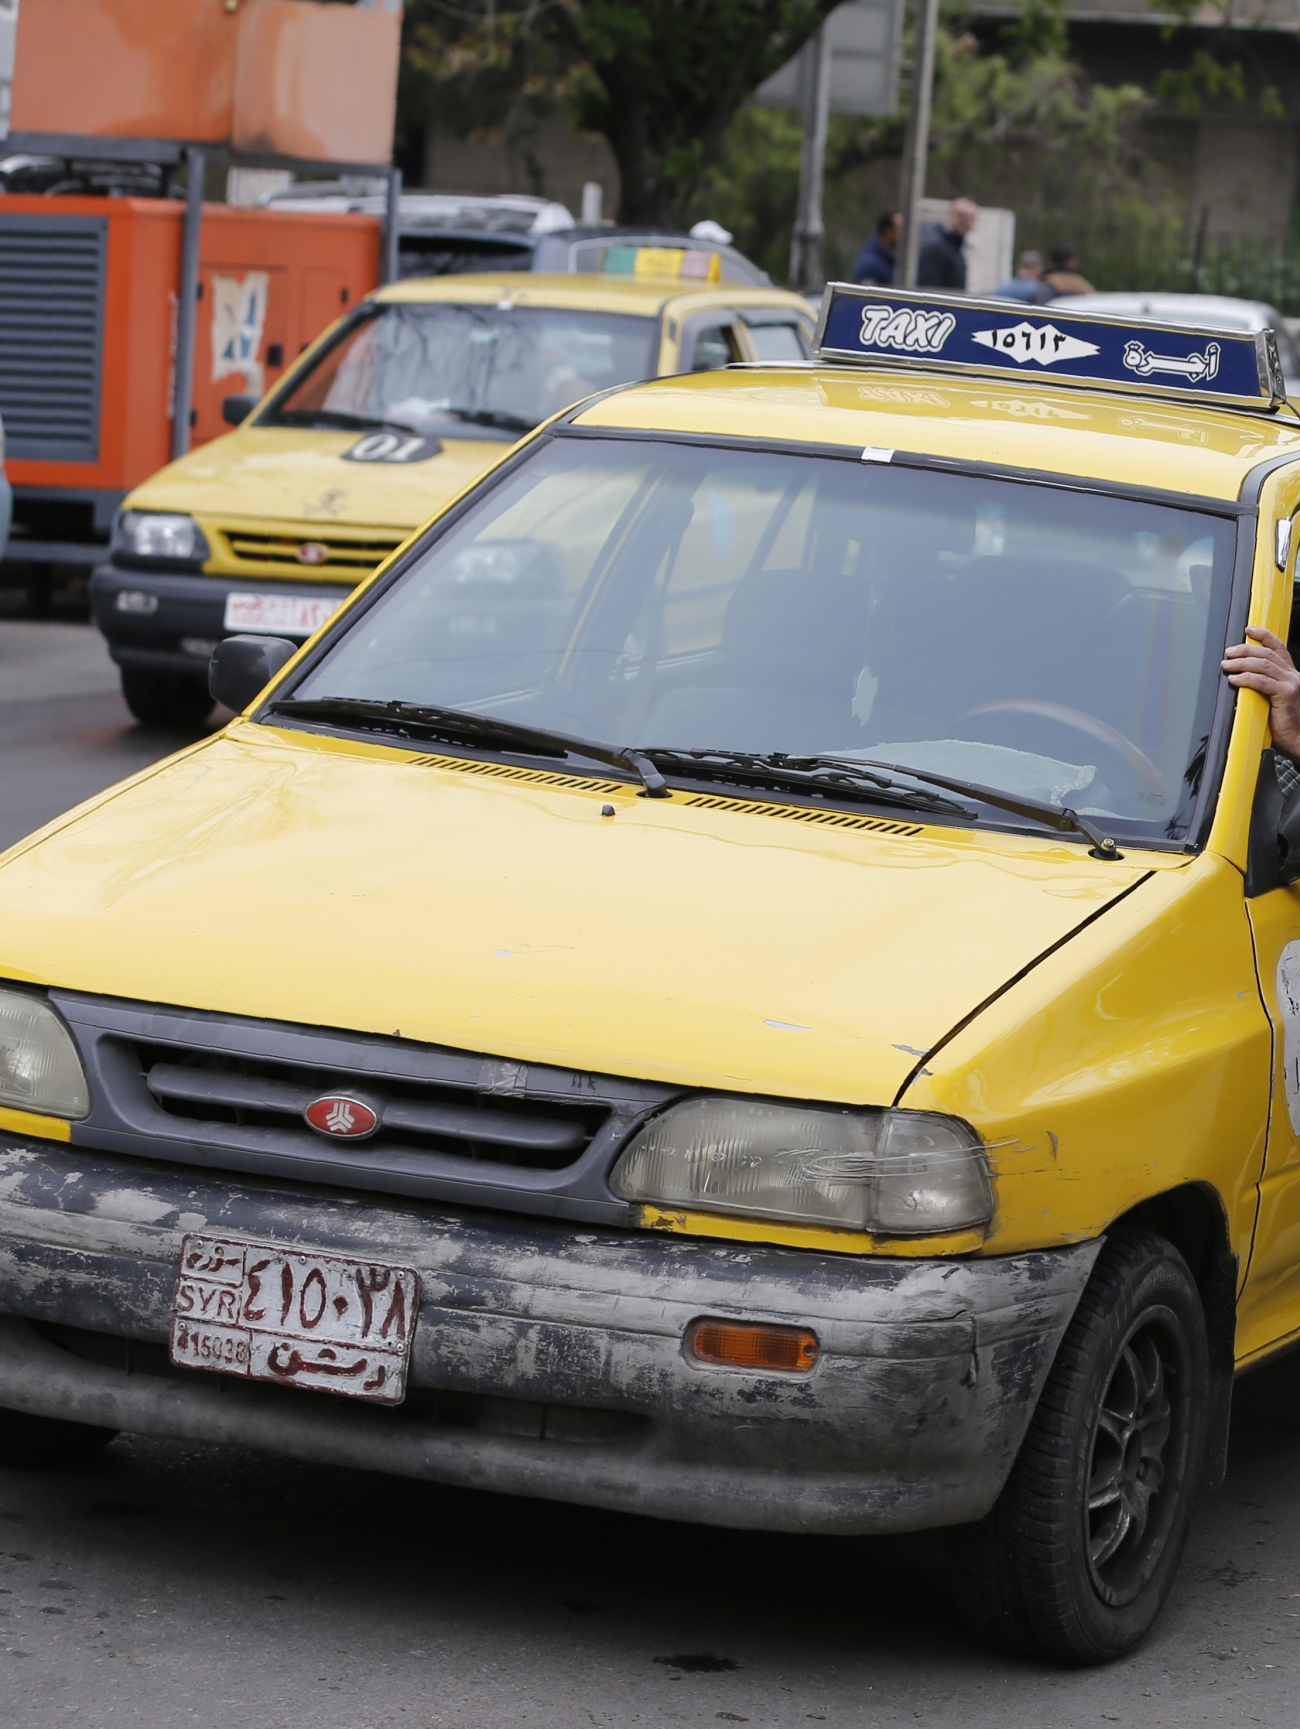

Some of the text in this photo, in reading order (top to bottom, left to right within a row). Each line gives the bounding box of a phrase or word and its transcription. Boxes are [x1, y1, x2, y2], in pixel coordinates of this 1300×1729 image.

[859, 304, 956, 353] TAXI
[992, 329, 1066, 353] ١٥٦١٣
[176, 1284, 237, 1319] SYR
[244, 1259, 406, 1340] ٤١٥٠٣٨
[177, 1331, 249, 1364] 415038
